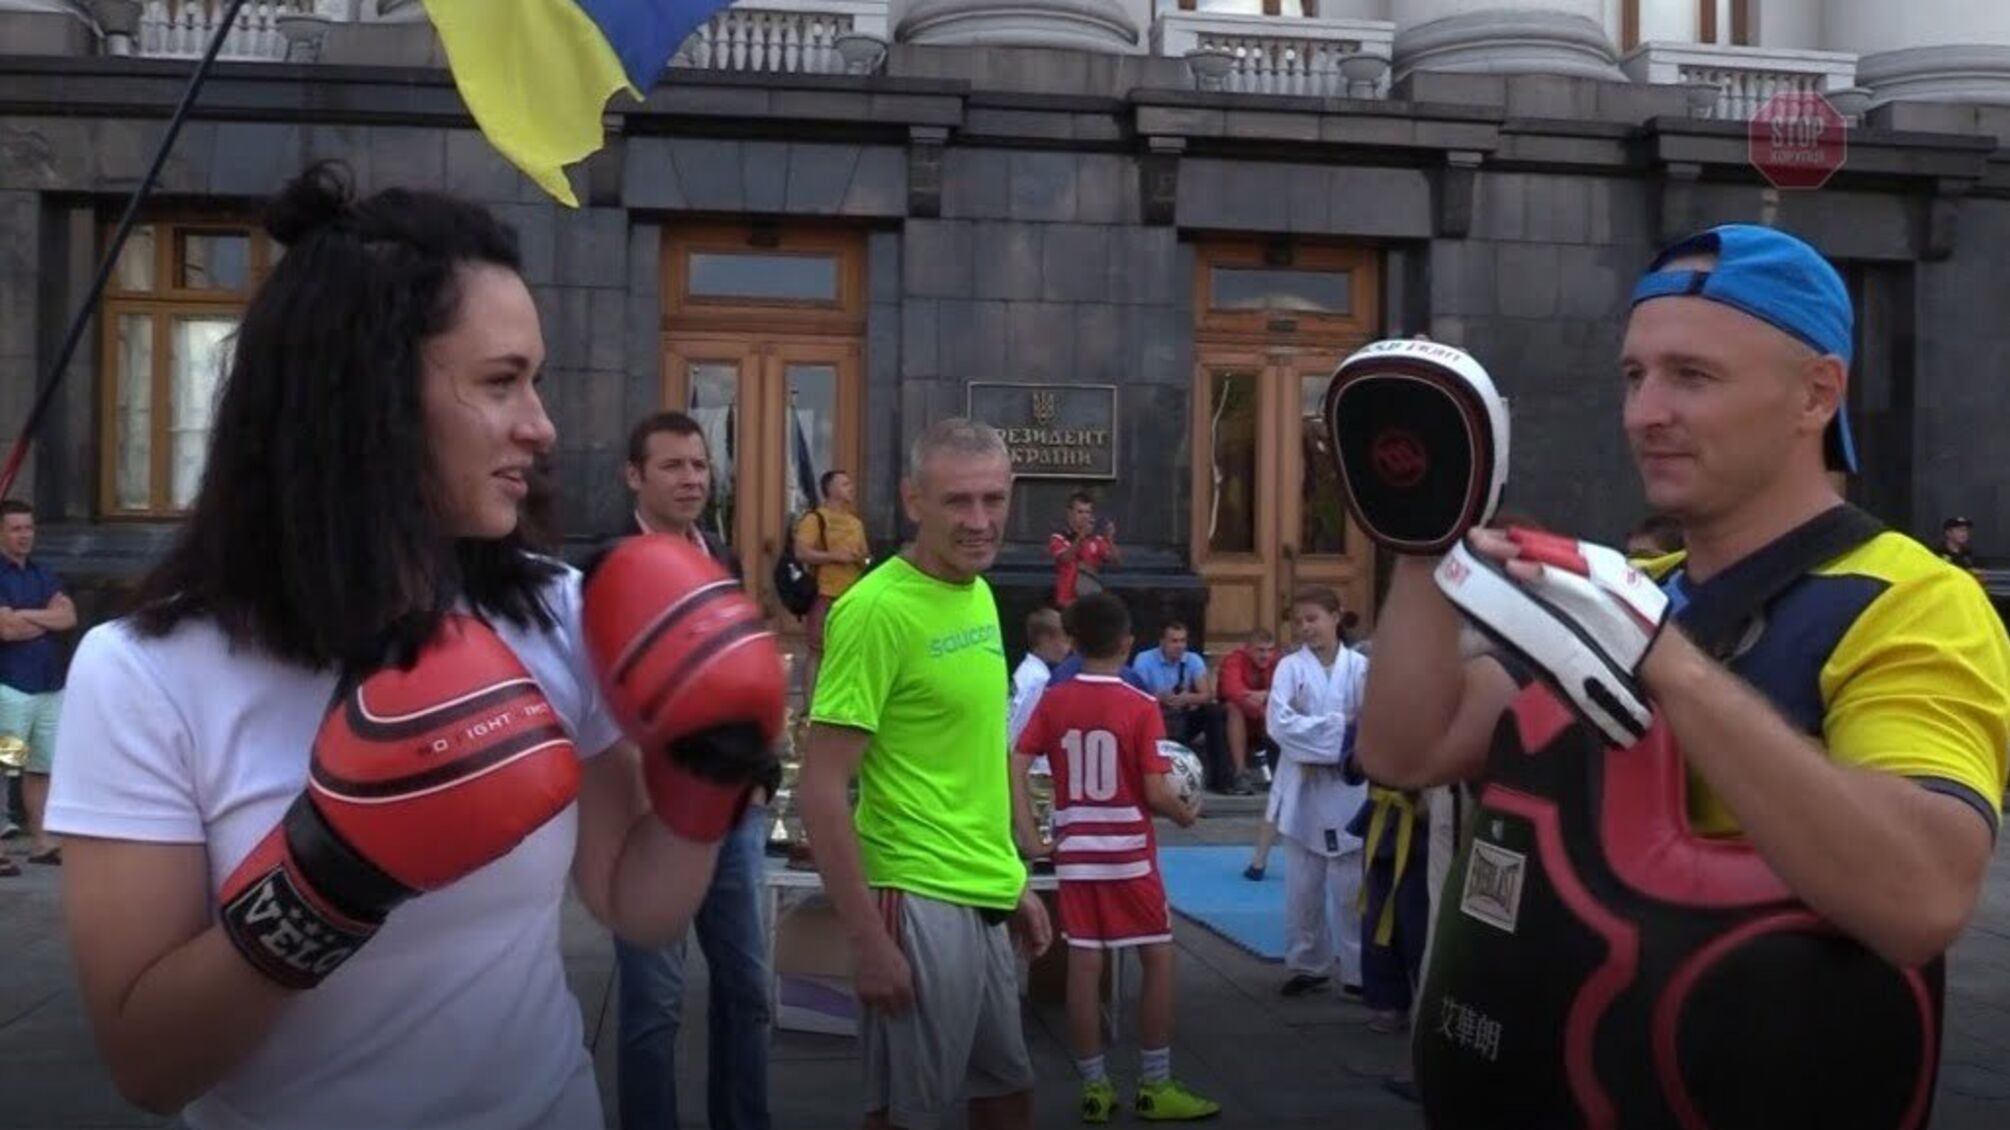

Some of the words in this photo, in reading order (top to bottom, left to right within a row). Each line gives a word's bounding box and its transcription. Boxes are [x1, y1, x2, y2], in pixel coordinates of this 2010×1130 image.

[995, 428, 1105, 446] РЕЗИДЕНТ
[1007, 447, 1092, 465] КРАЇНИ
[1061, 728, 1118, 801] 10
